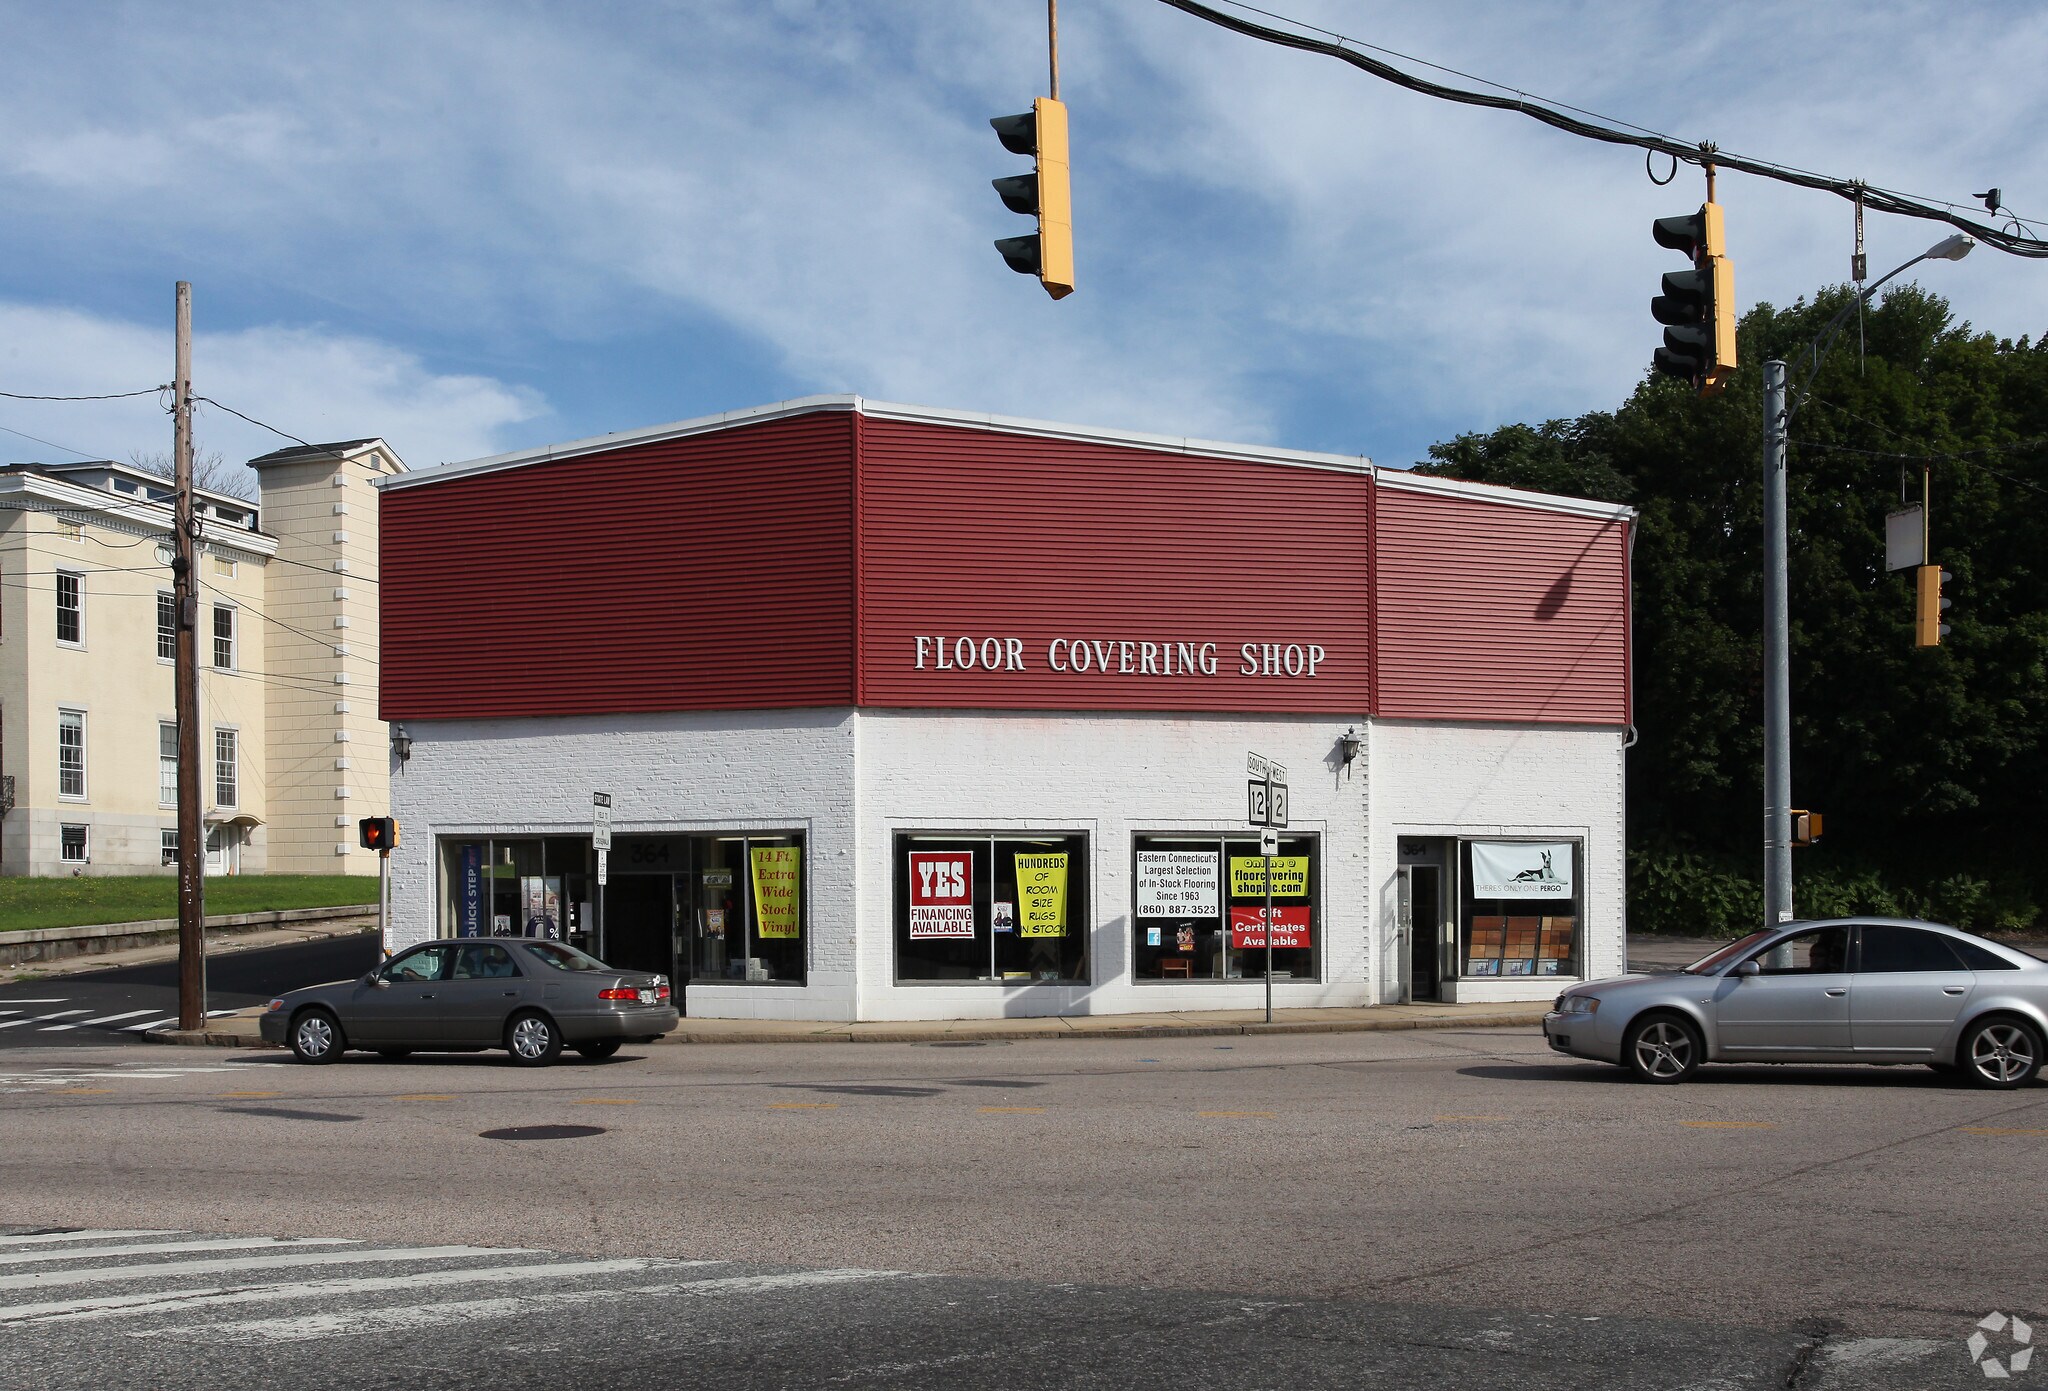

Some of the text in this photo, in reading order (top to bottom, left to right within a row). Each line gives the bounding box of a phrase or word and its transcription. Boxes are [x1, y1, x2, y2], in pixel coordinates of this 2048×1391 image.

[914, 636, 1326, 678] FLOOR COVERING SHOP
[1273, 766, 1285, 782] WEST
[1251, 790, 1265, 816] 12
[1275, 793, 1284, 818] 2
[630, 843, 670, 863] 364
[1402, 843, 1427, 856] 364
[758, 850, 793, 863] 14 Ft.
[1138, 853, 1217, 863] Eastern Connecticut's
[1017, 857, 1066, 869] HUNDREDS
[1243, 859, 1285, 868] Onlne
[758, 868, 796, 880] Extra
[1034, 872, 1050, 882] OF
[1144, 865, 1212, 877] Largest Selection
[1235, 869, 1304, 882] floorcvering
[468, 868, 477, 897] STEP
[918, 861, 965, 898] YES
[1139, 879, 1216, 890] of In-Stock Flooring
[762, 885, 794, 898] Wide
[1025, 885, 1059, 895] ROOM
[1237, 881, 1302, 895] shopic.com
[1503, 884, 1522, 893] ONLY
[1523, 884, 1539, 893] ONE
[1540, 884, 1562, 893] PERGO
[1156, 891, 1200, 901] Since 1963
[760, 903, 796, 915] Stock
[1031, 898, 1053, 908] SIZE
[911, 908, 972, 921] FINANCING
[1028, 911, 1056, 921] RUGS
[1138, 905, 1216, 917] (860) 887-3523
[468, 901, 478, 938] QUICK
[762, 920, 796, 935] Vinyl
[911, 920, 972, 933] AVAILABLE
[1021, 924, 1066, 934] N STOCK
[1235, 922, 1306, 932] Certiicates
[1243, 936, 1298, 946] Avalable
